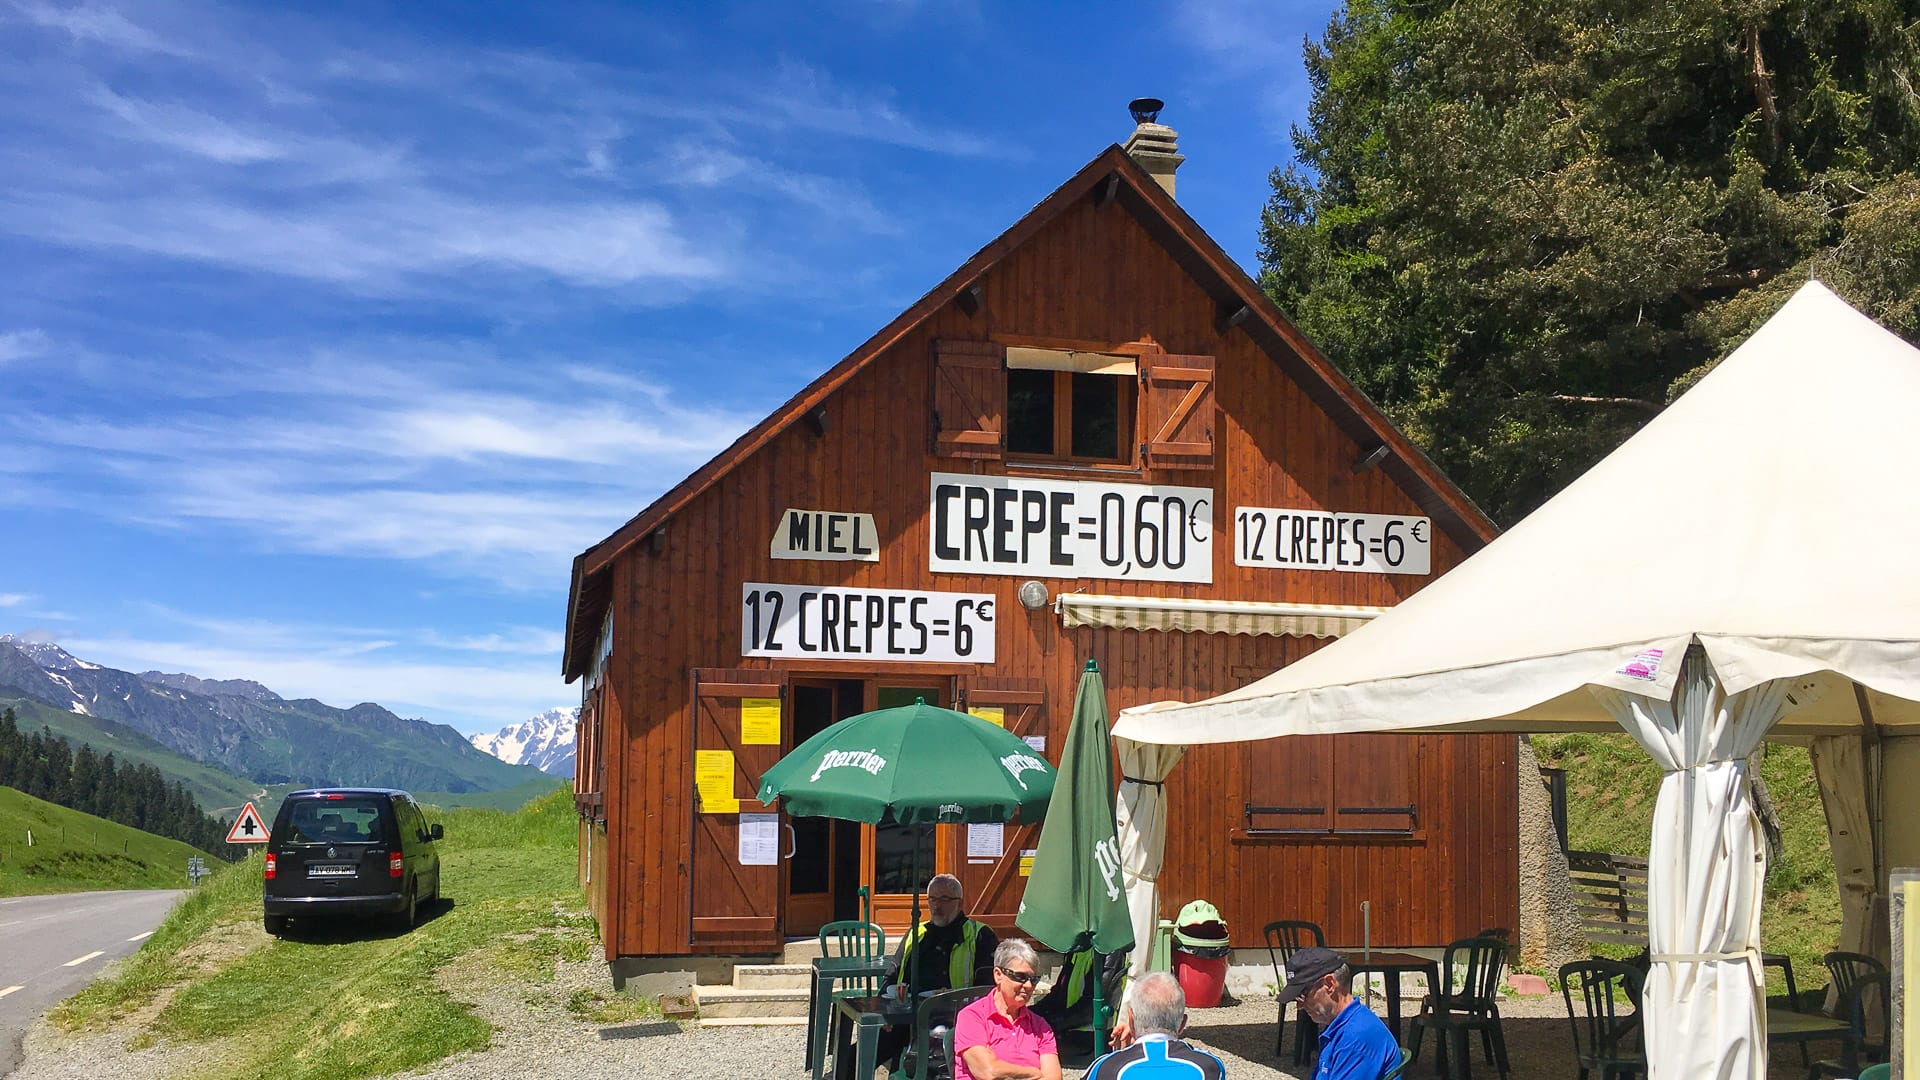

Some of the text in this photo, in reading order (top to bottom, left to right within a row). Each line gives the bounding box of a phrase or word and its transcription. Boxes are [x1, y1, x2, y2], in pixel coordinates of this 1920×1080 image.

[789, 511, 872, 555] MIEL
[1238, 512, 1267, 561] 12
[745, 590, 784, 651] 12
